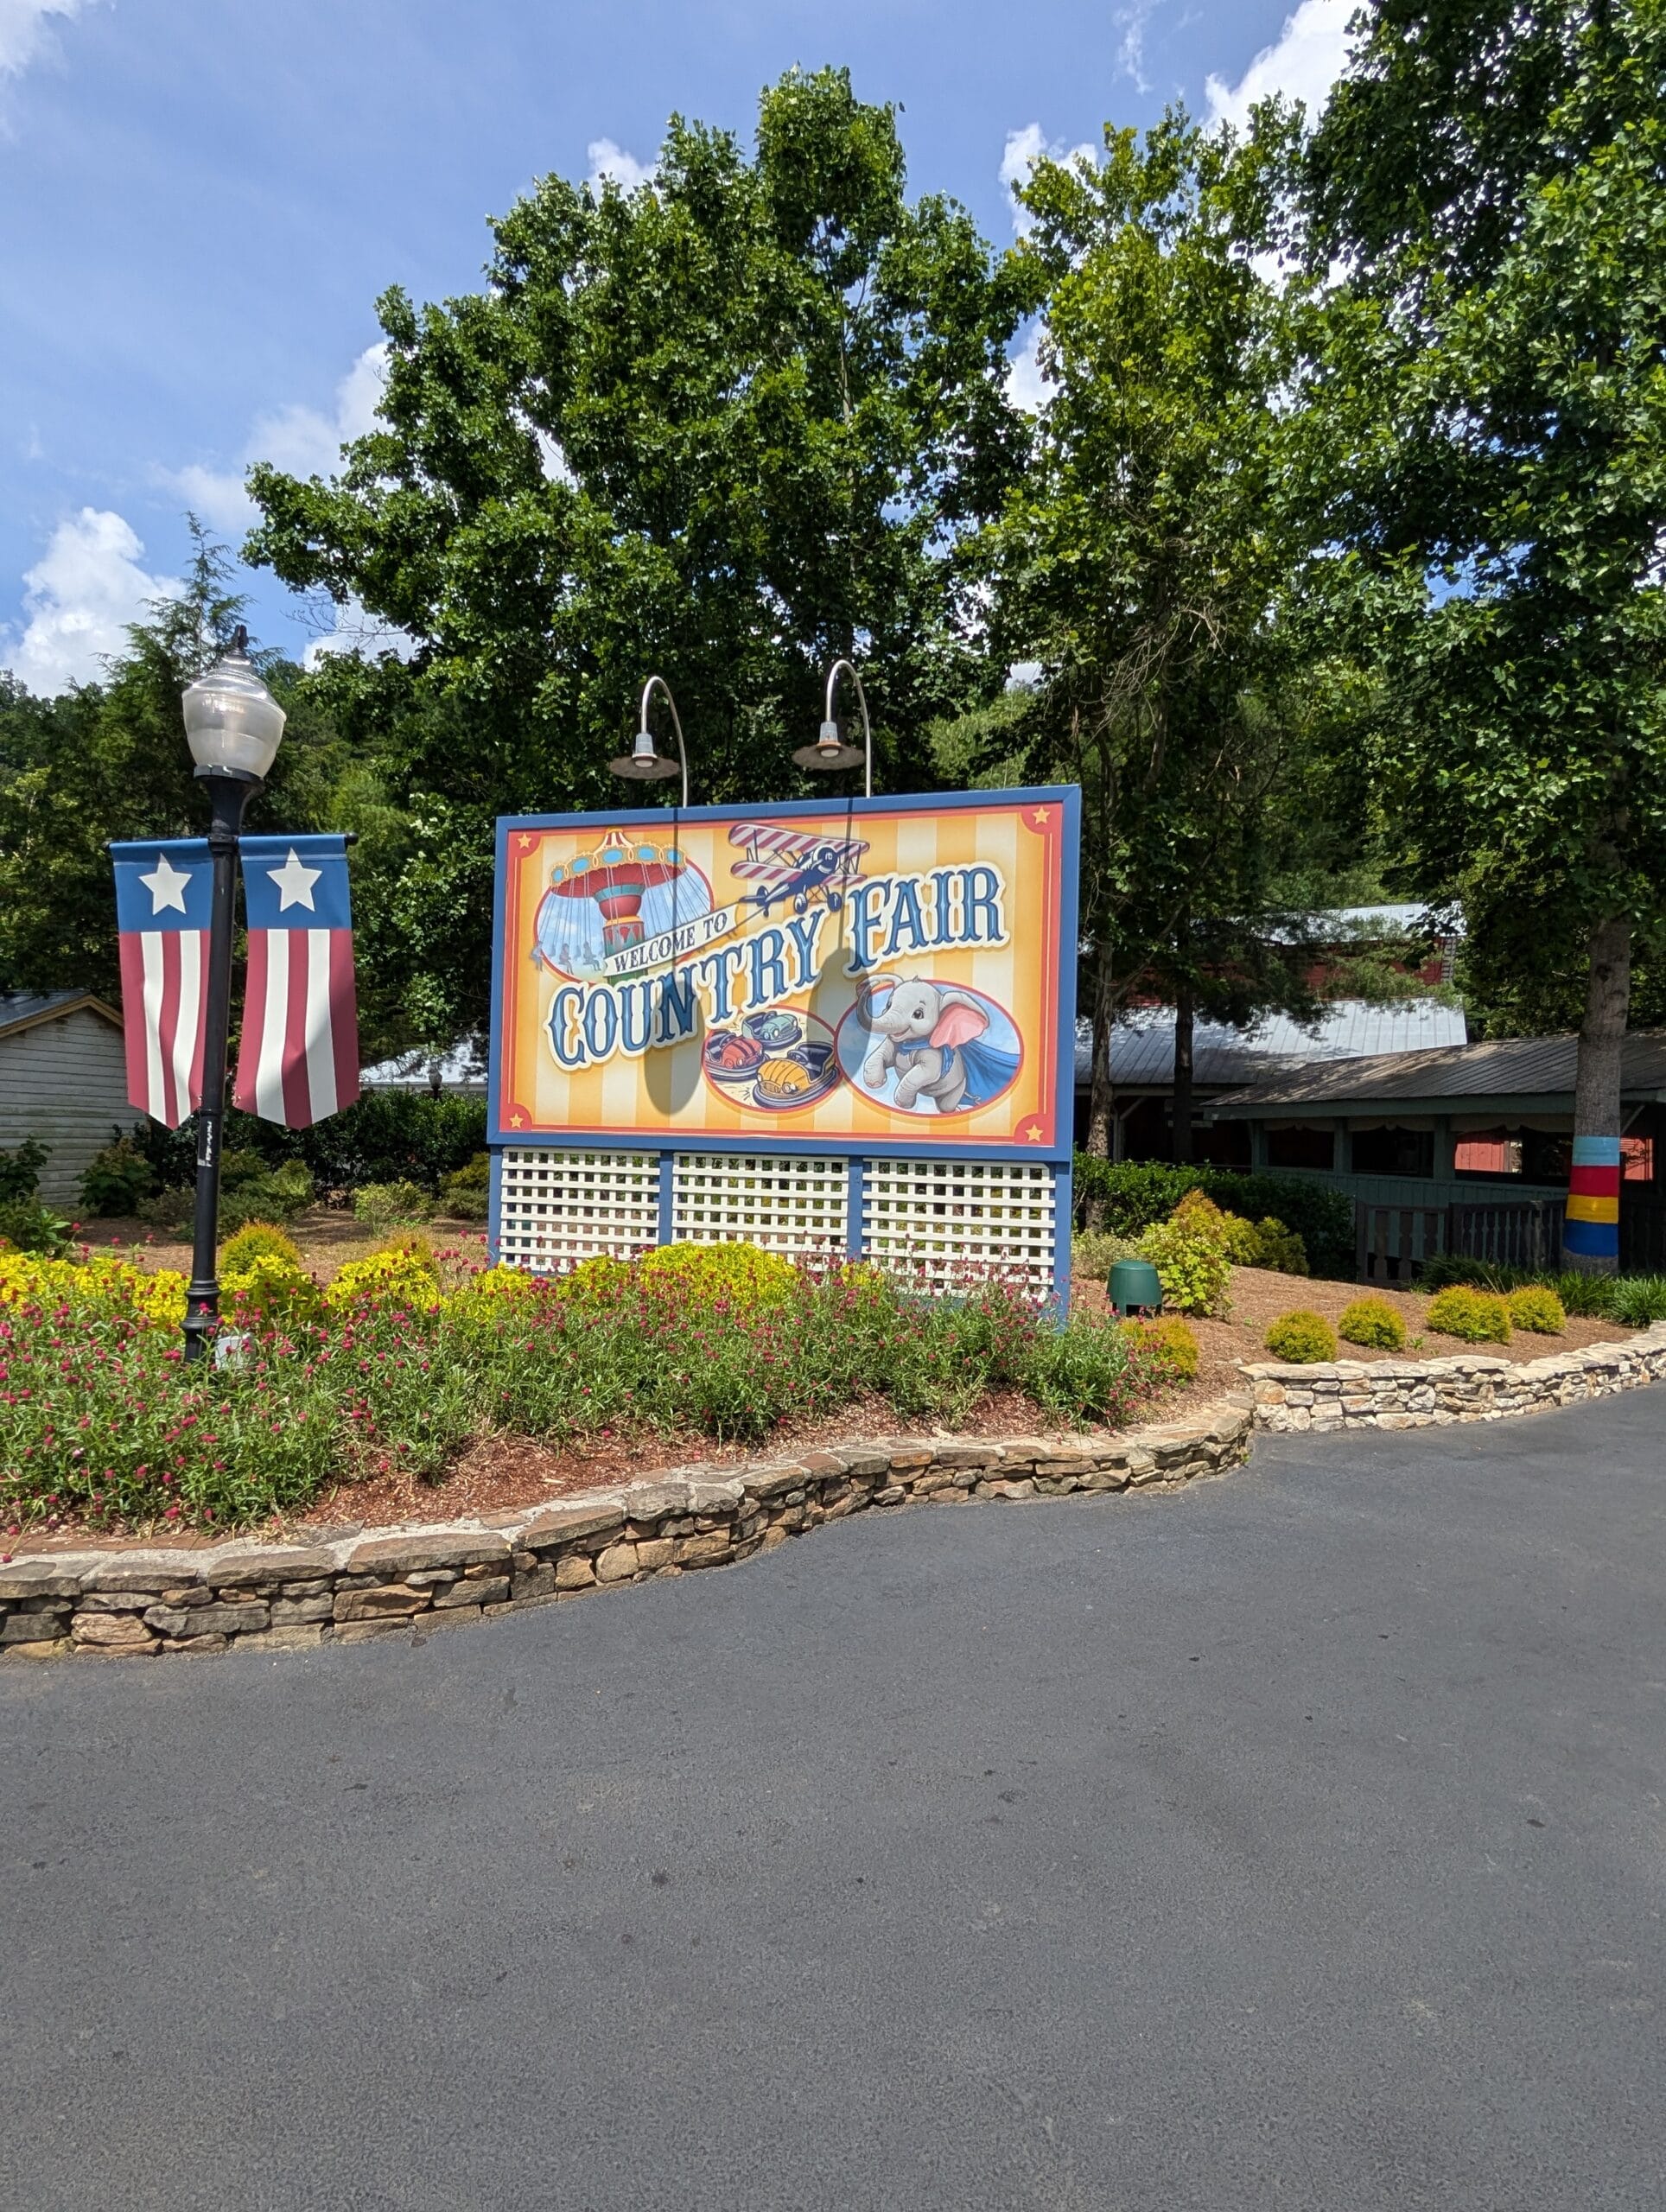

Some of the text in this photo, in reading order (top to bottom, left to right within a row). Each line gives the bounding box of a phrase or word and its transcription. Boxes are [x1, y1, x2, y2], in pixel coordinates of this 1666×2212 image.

[548, 867, 1007, 1066] COUNTRY FAIR
[614, 912, 728, 973] WELCOME TO
